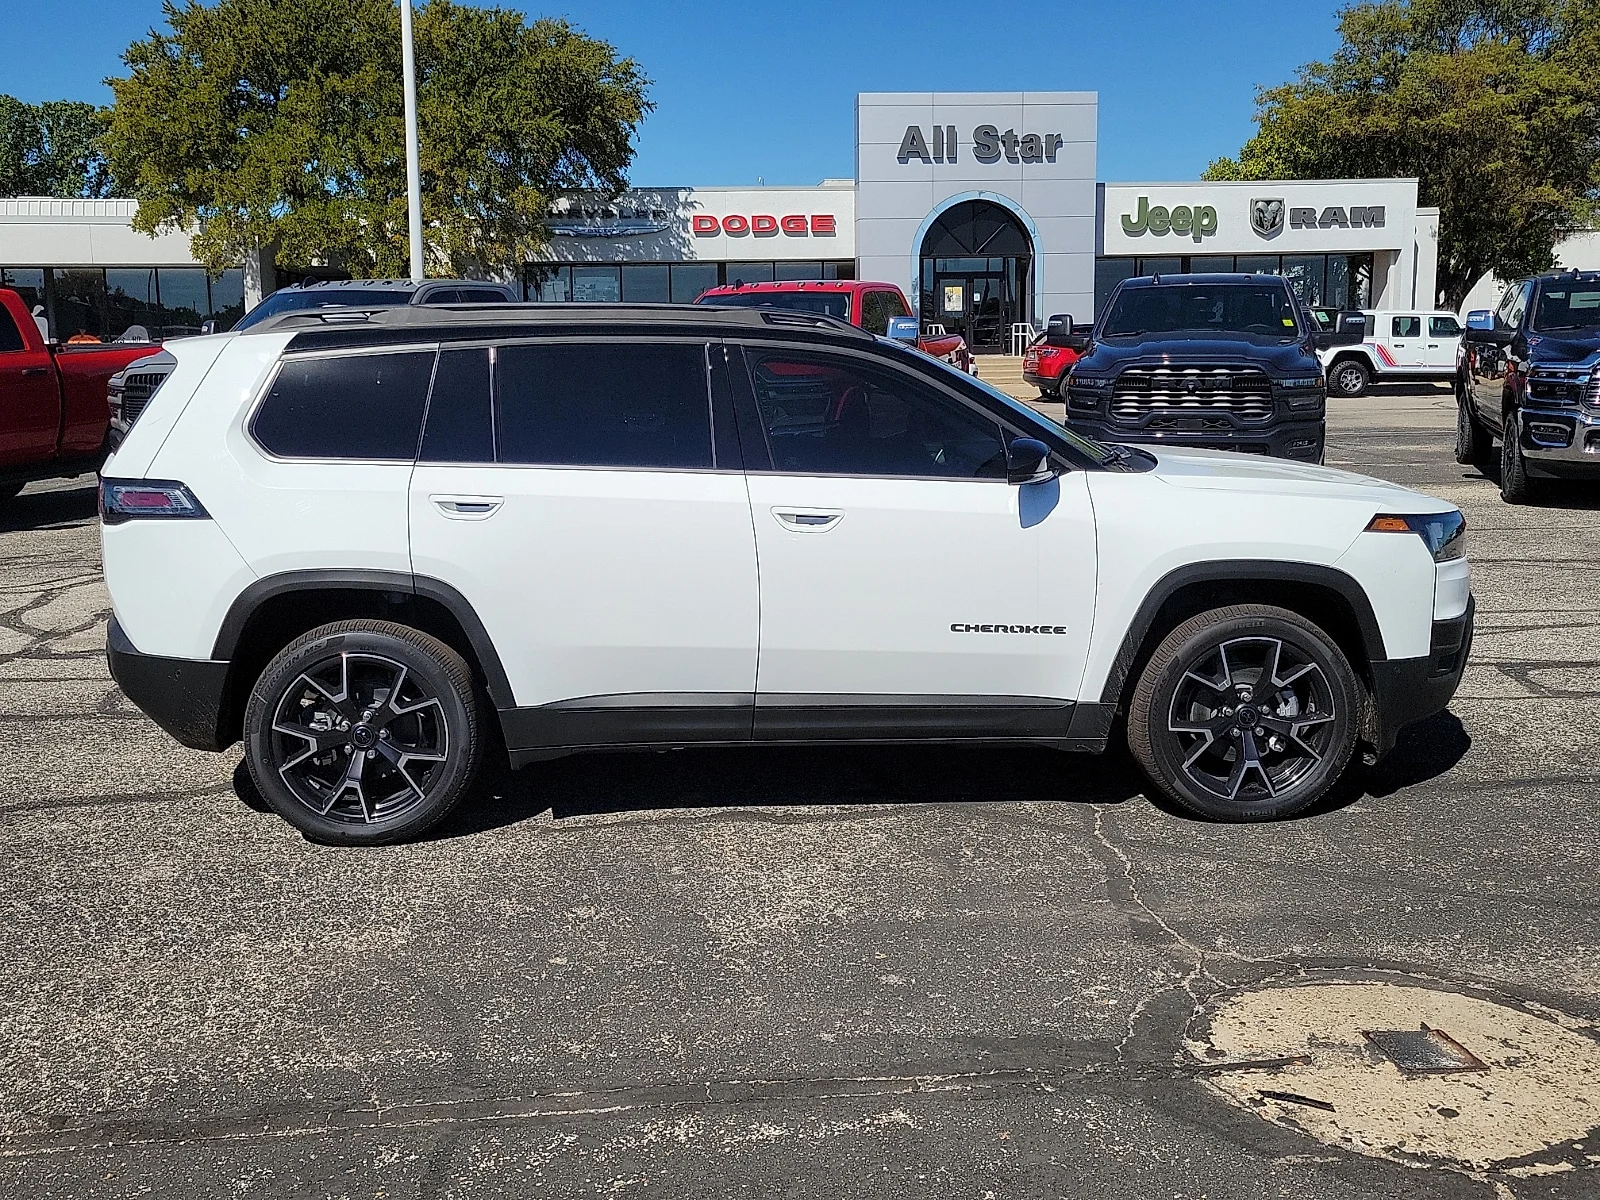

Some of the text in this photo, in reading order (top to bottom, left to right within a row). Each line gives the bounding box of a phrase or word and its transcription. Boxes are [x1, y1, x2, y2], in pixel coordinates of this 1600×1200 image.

[897, 124, 1063, 161] All Star
[693, 214, 835, 236] DODGE
[1121, 197, 1217, 242] Jeep
[1290, 206, 1386, 228] RAM
[950, 623, 1067, 635] CHEROKEE
